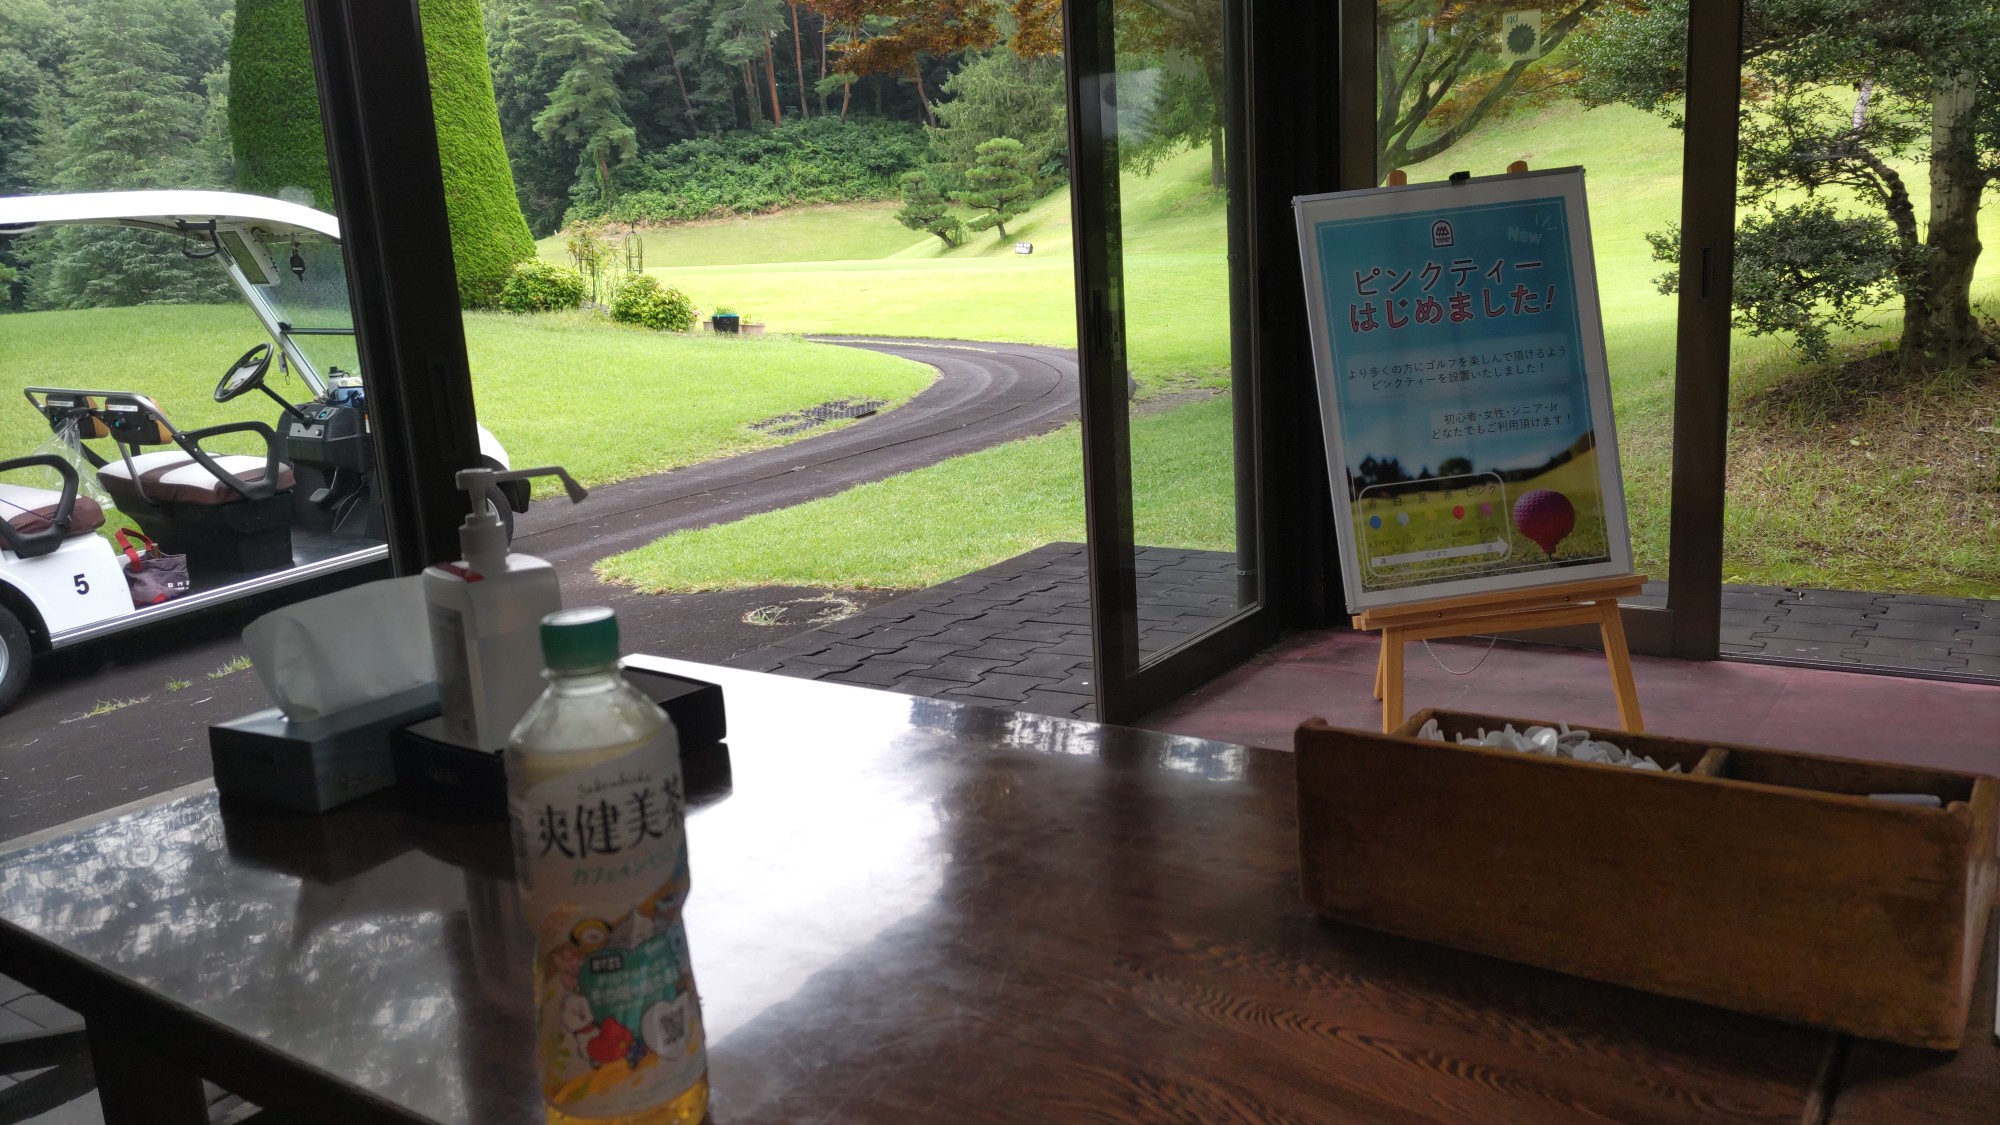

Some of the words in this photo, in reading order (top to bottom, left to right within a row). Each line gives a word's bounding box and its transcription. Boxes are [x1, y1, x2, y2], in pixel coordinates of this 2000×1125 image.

[1507, 226, 1543, 245] New
[1354, 258, 1543, 297] ピンクティー
[1349, 284, 1556, 334] はじめました!
[1347, 345, 1567, 381] より多くの方にゴルフを楽しんで頂けるよう
[1372, 362, 1546, 391] ピンクティーを設置いたしました！
[1466, 485, 1497, 498] ピンク
[73, 573, 90, 595] 5
